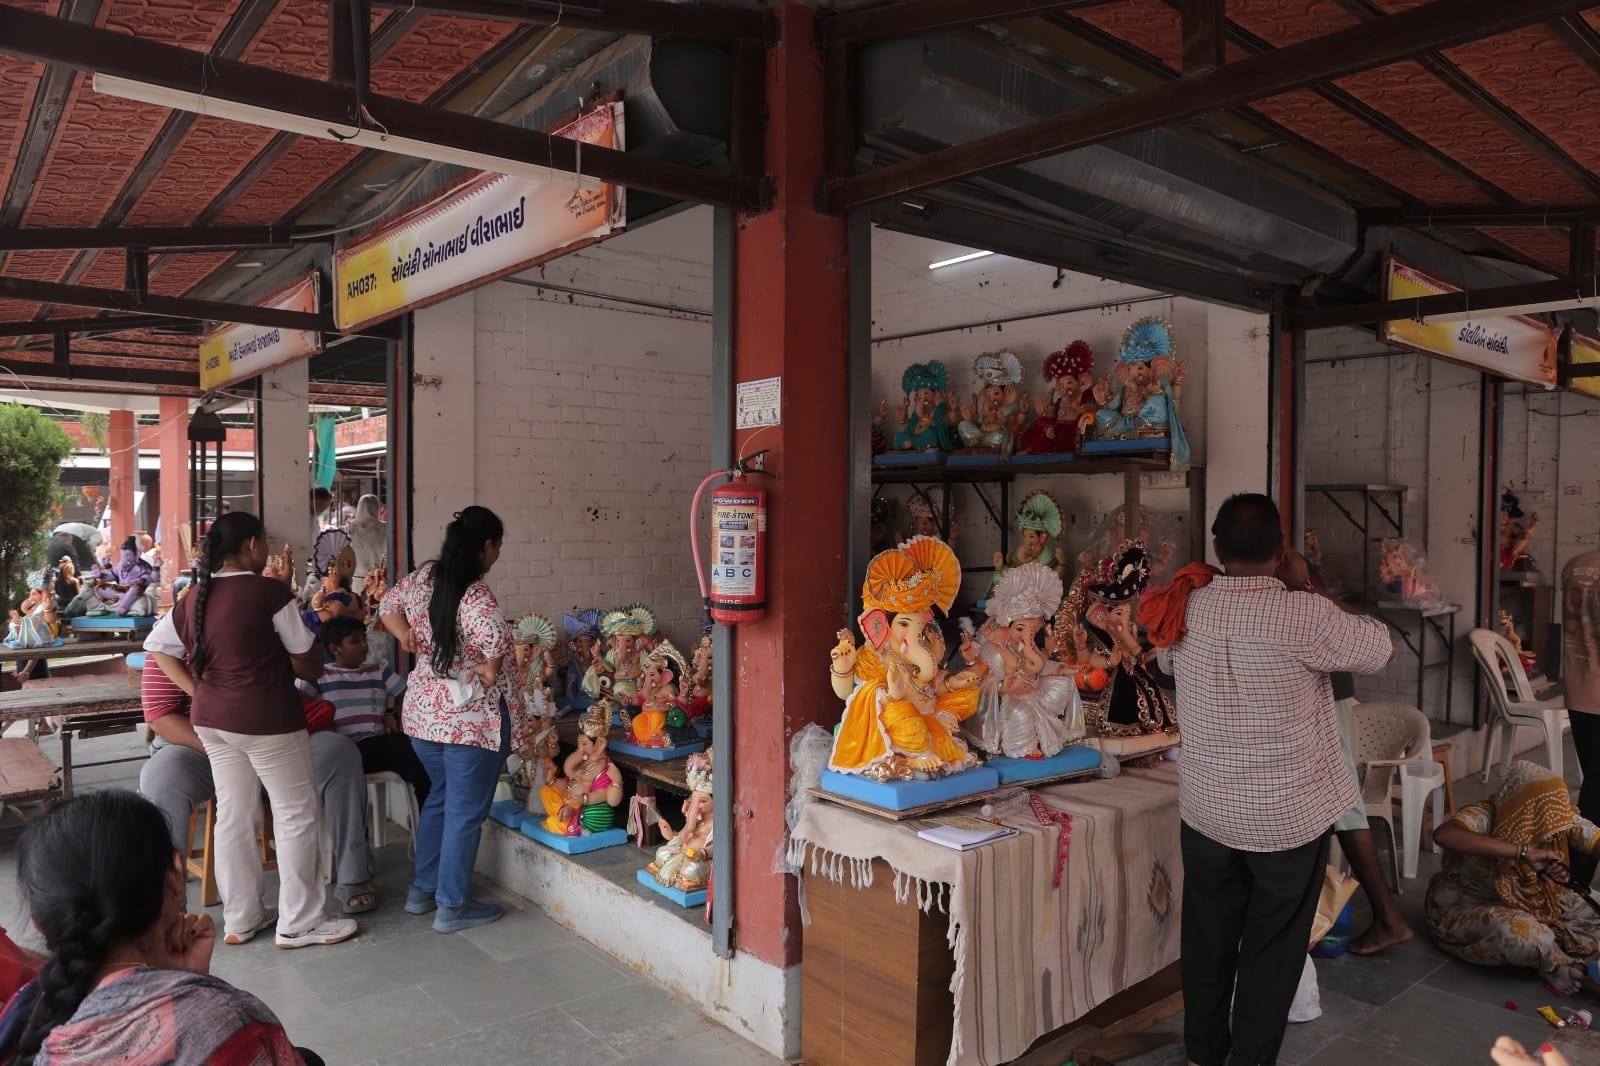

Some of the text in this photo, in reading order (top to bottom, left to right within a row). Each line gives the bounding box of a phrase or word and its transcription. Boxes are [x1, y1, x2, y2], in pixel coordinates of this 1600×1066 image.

[347, 273, 377, 299] AH037:
[392, 247, 421, 283] સોલંકી
[423, 225, 469, 270] સોનાભાઈ
[471, 196, 525, 247] વીરાભાઈ
[717, 511, 756, 519] FIRE-STONE
[713, 567, 751, 577] A B C
